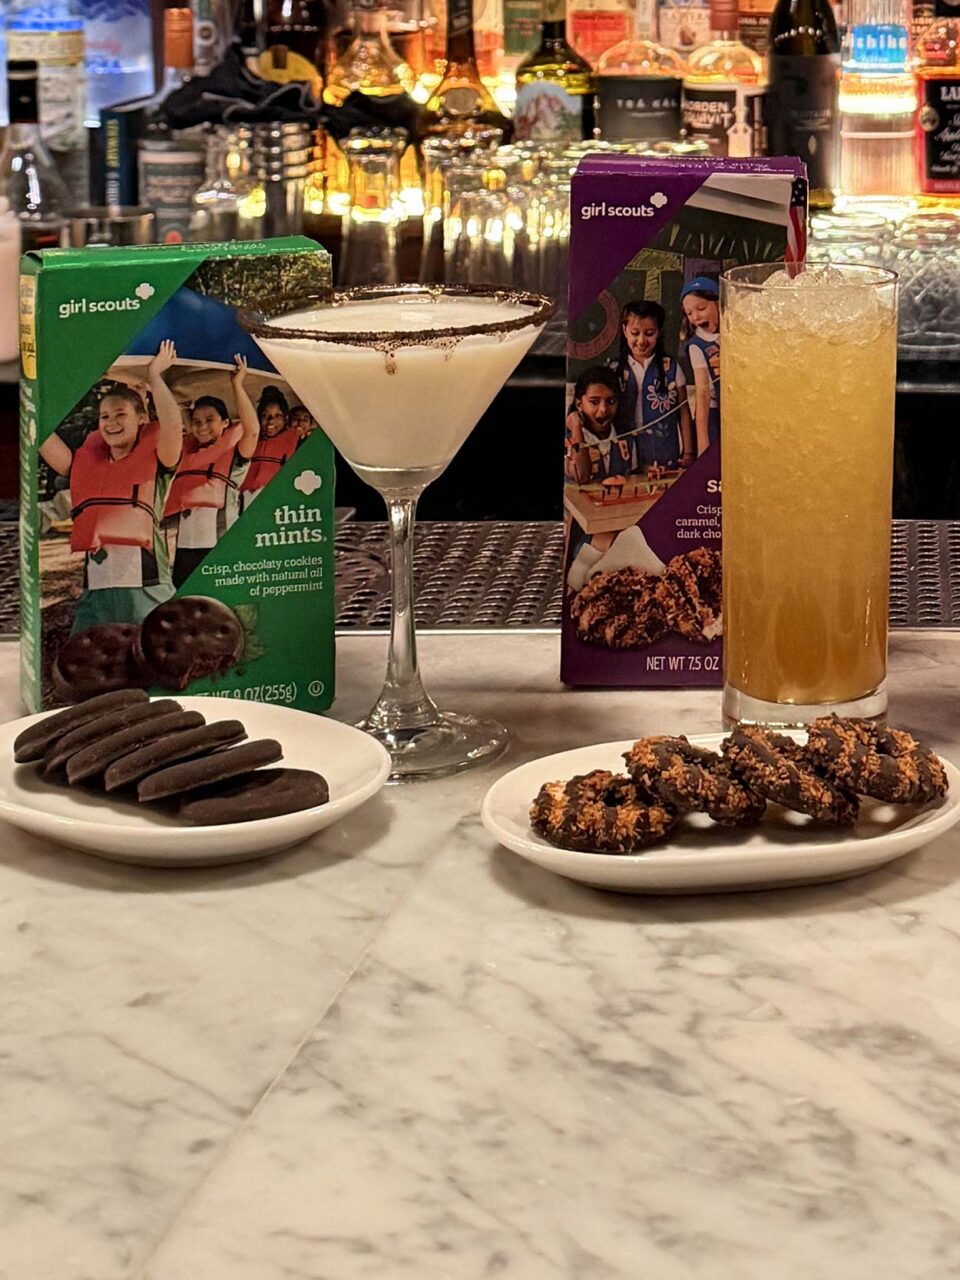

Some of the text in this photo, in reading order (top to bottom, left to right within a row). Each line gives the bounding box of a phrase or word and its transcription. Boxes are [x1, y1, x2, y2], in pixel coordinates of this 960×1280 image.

[581, 203, 655, 219] girl scouts
[59, 294, 141, 318] girl scouts
[274, 505, 322, 525] thin
[675, 516, 721, 528] caramel,
[255, 527, 323, 548] mints
[677, 529, 701, 539] dark
[202, 556, 323, 577] Crisp, chocolaty cookies
[214, 568, 323, 588] made with natural oil
[250, 582, 323, 598] of peppermint
[646, 656, 720, 671] NET WT 7.5 OZ
